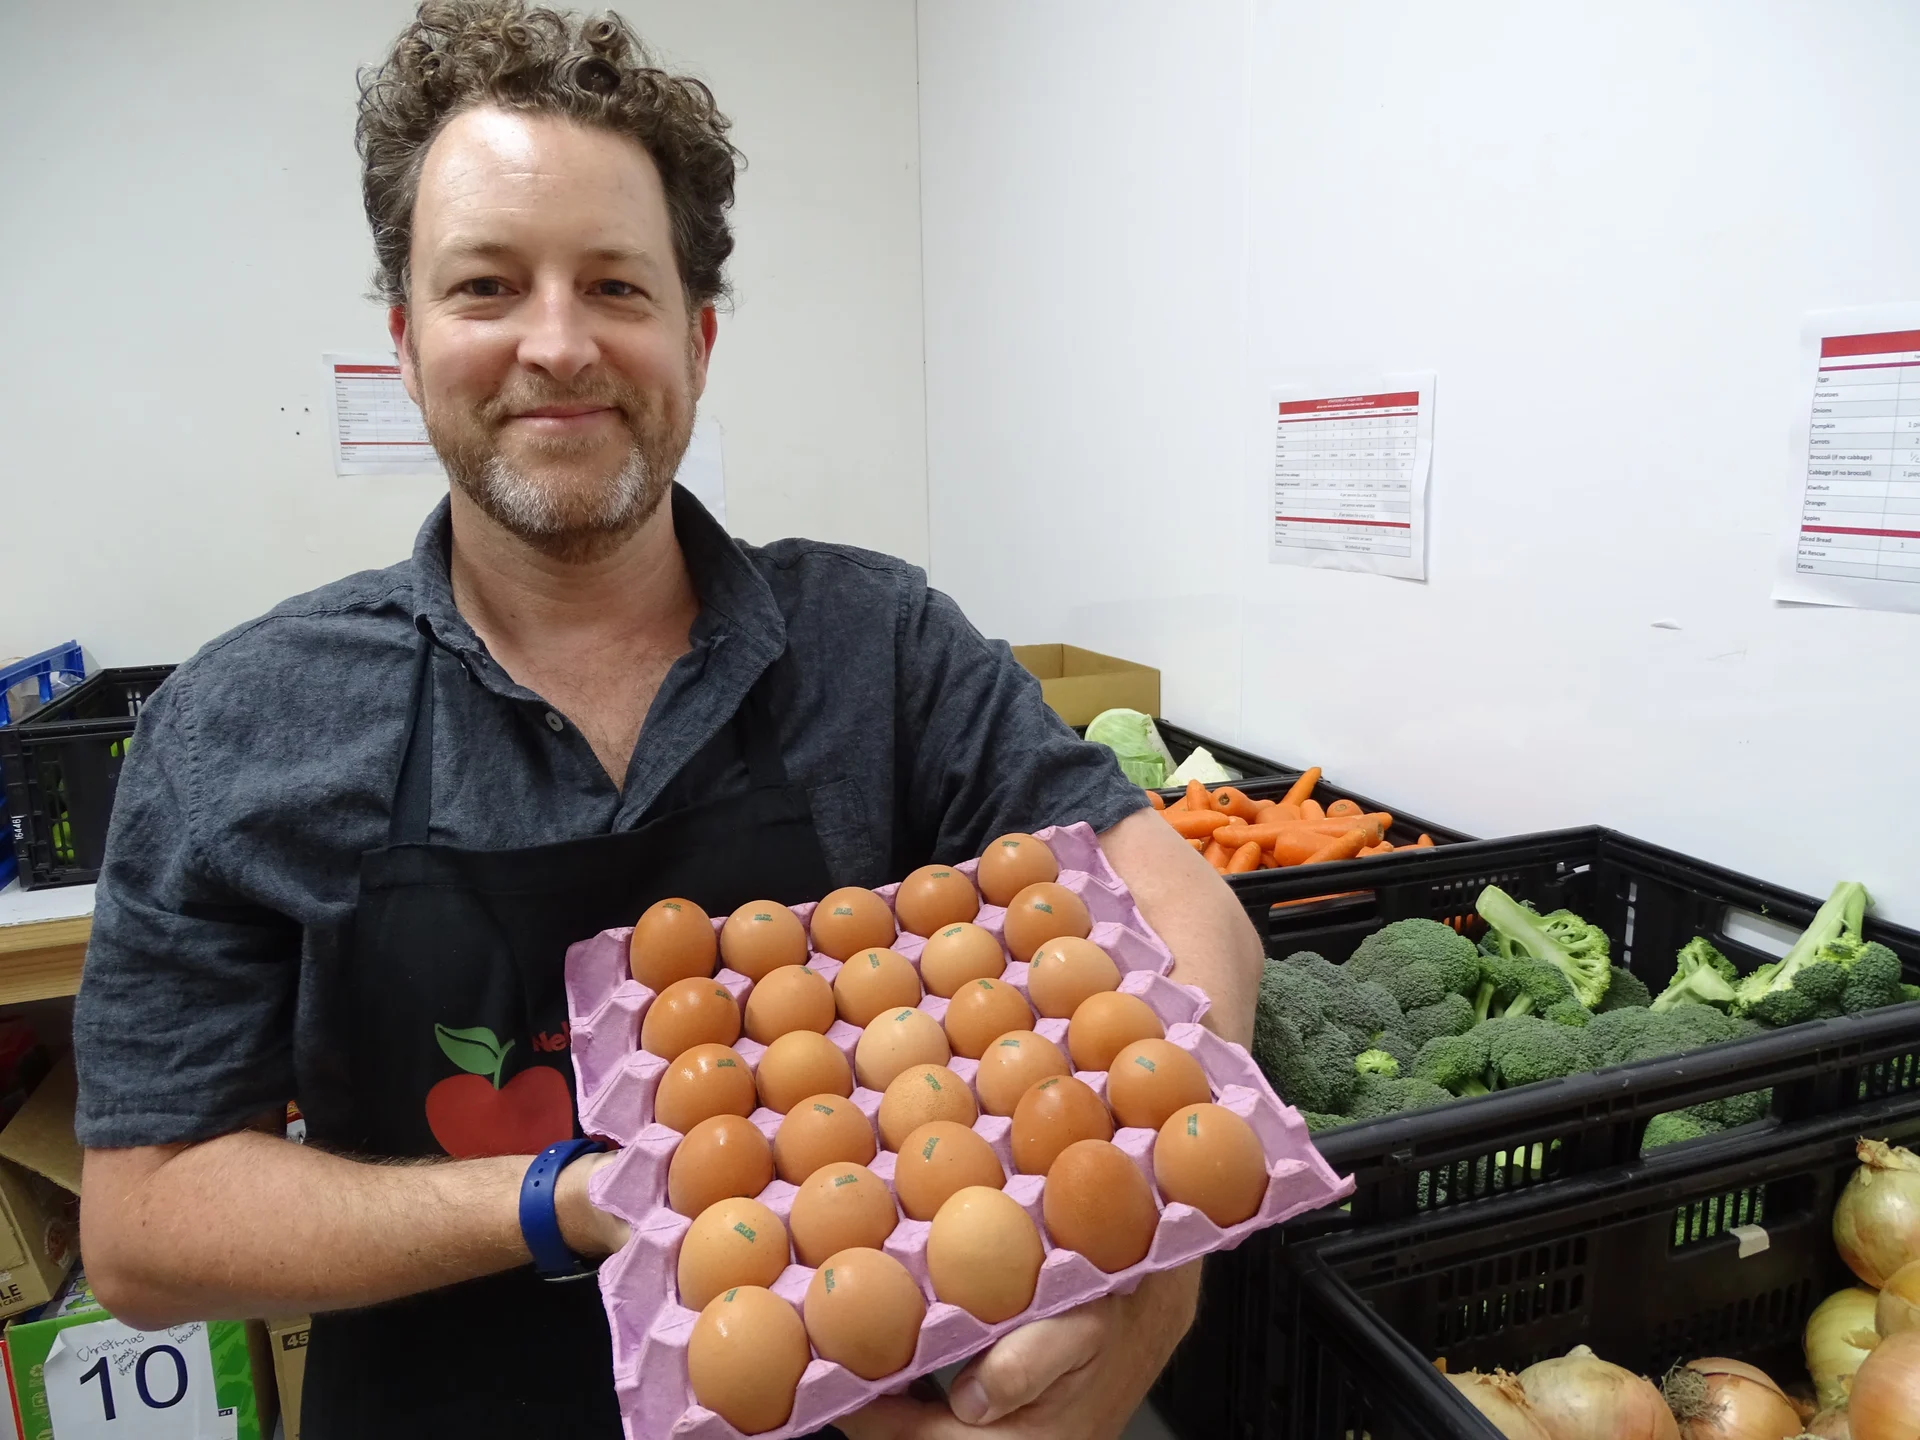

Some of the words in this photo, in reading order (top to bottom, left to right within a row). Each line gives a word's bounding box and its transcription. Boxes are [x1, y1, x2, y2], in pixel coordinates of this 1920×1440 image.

[1847, 453, 1872, 461] cabbage)
[76, 1332, 145, 1363] Christmas
[79, 1344, 189, 1421] 10
